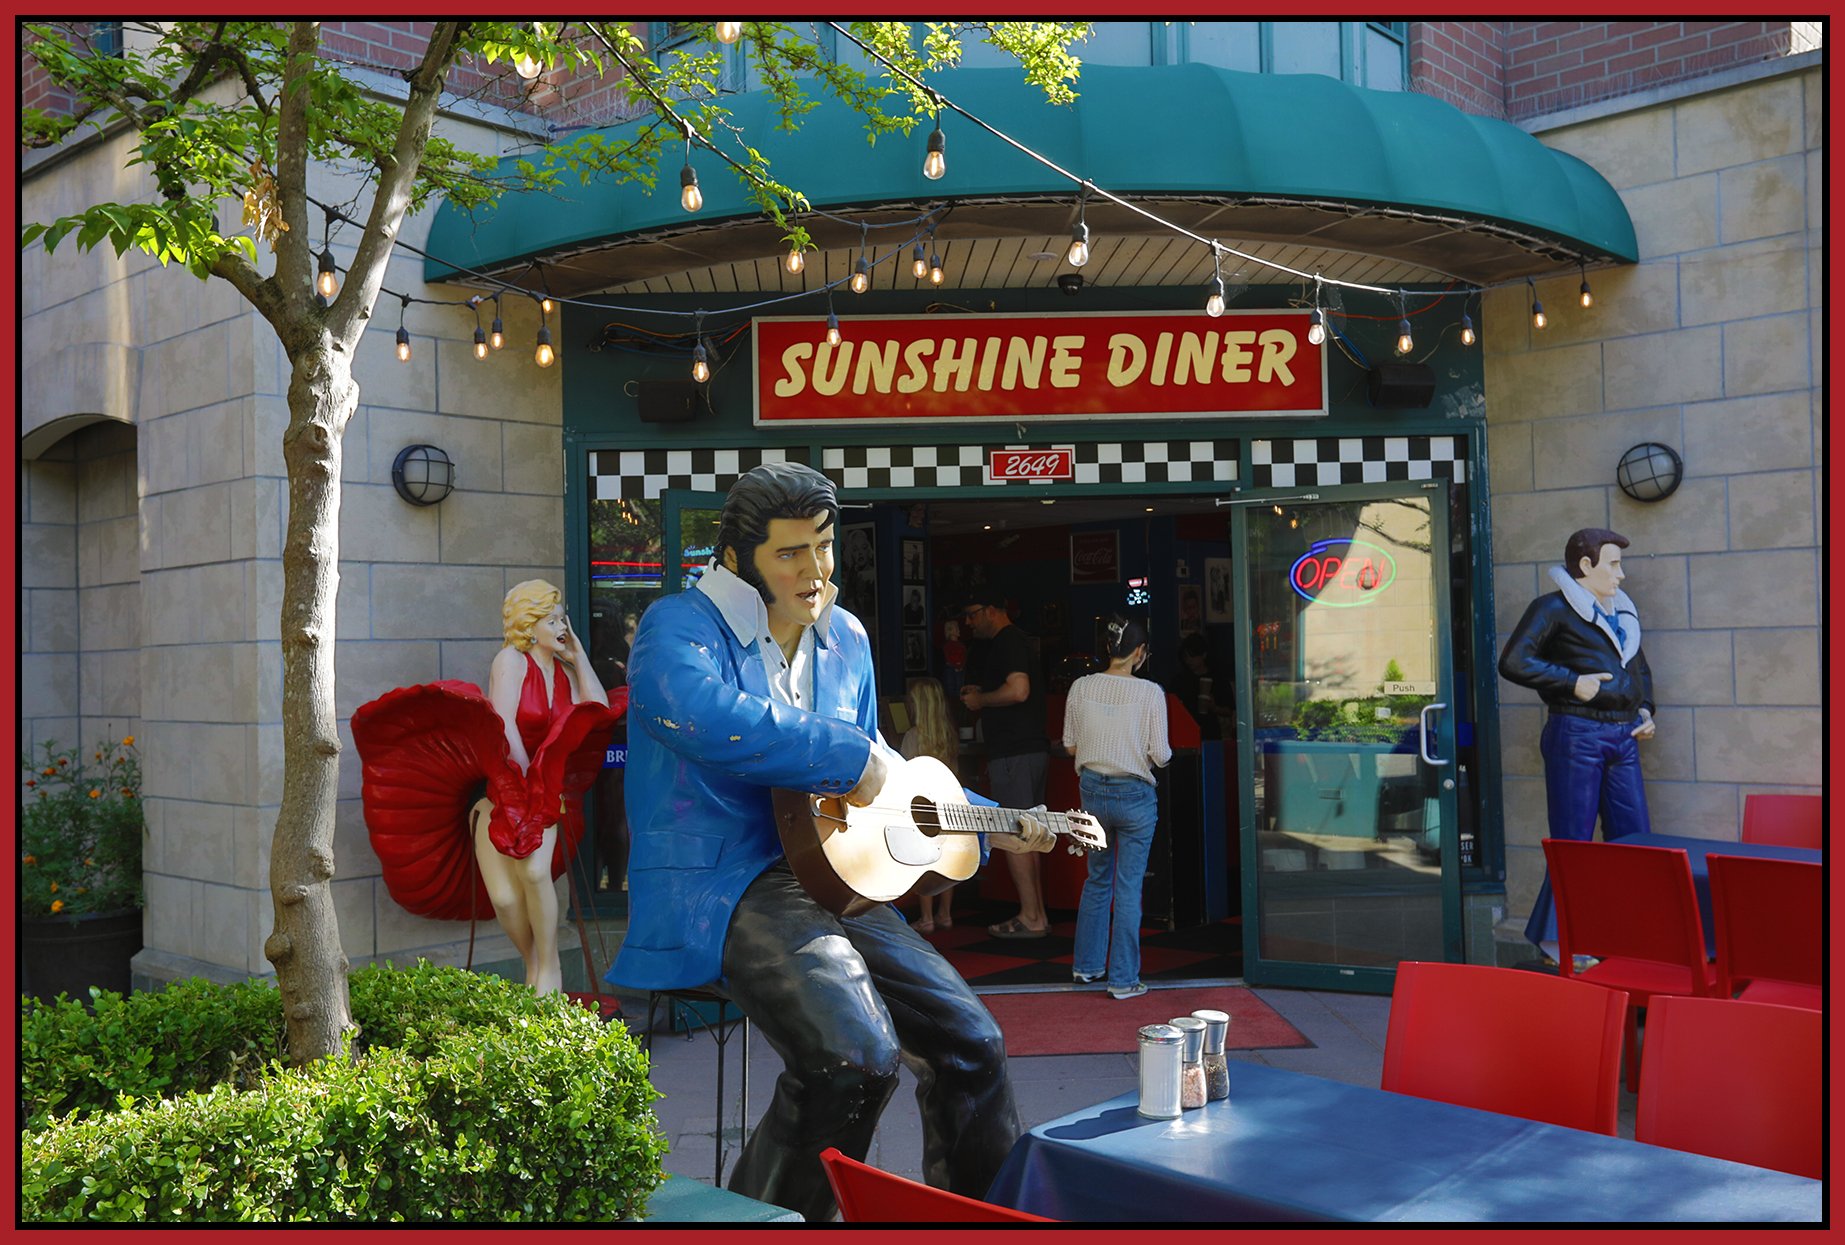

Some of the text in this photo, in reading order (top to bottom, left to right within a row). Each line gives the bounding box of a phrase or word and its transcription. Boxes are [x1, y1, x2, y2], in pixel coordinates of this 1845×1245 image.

[773, 327, 1298, 398] SUNSHINE DINER
[1004, 453, 1060, 476] 2649
[1295, 556, 1386, 591] OPEN
[1392, 684, 1416, 692] Push
